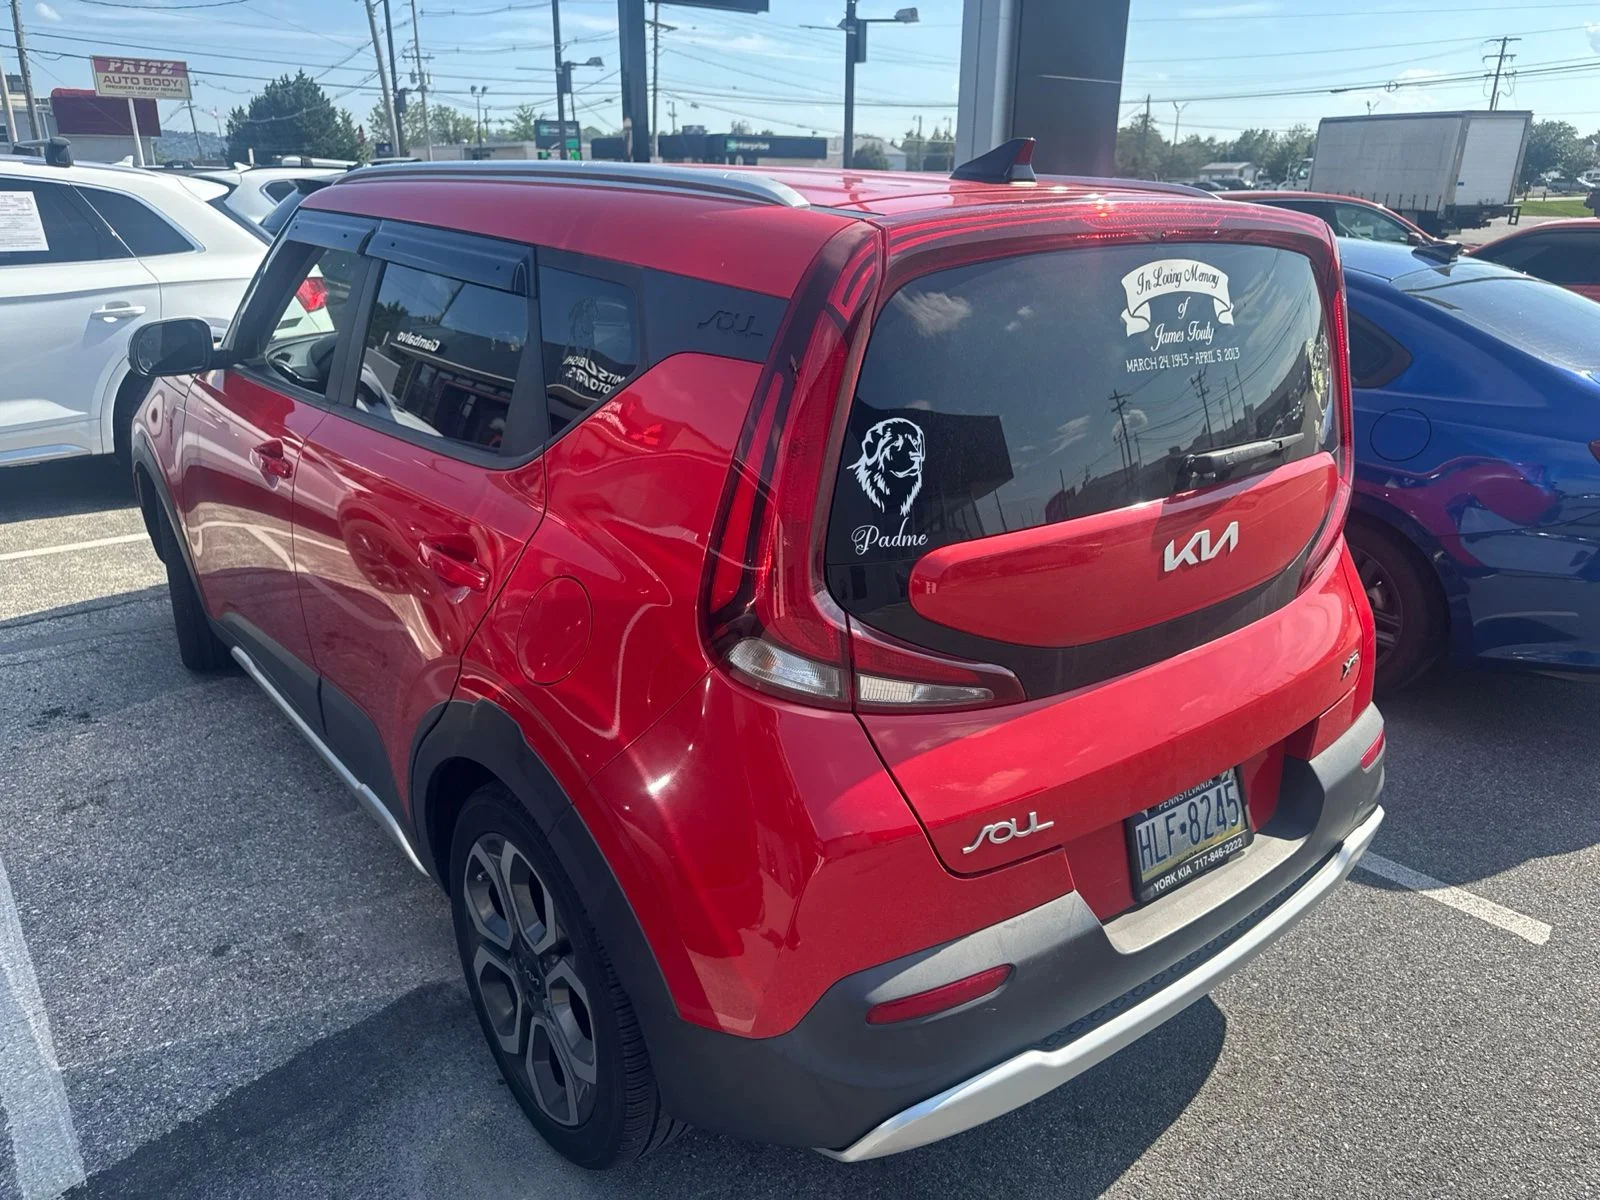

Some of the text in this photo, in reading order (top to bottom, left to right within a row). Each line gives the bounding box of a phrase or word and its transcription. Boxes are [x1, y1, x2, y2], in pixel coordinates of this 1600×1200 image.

[103, 75, 140, 85] AUTO
[143, 77, 179, 87] BODY
[107, 59, 175, 75] PRITZ
[1136, 264, 1220, 295] In Loving Memory
[1178, 296, 1191, 320] of
[1151, 323, 1184, 351] James
[1126, 356, 1158, 373] MARCH
[851, 517, 928, 555] Padme
[1164, 521, 1239, 572] KIA
[1158, 778, 1214, 811] PENNSYLVANIA
[962, 811, 1054, 854] SOUL
[1154, 874, 1177, 892] YORK
[1177, 864, 1192, 880] KIA
[1194, 837, 1243, 871] 717-846-2222
